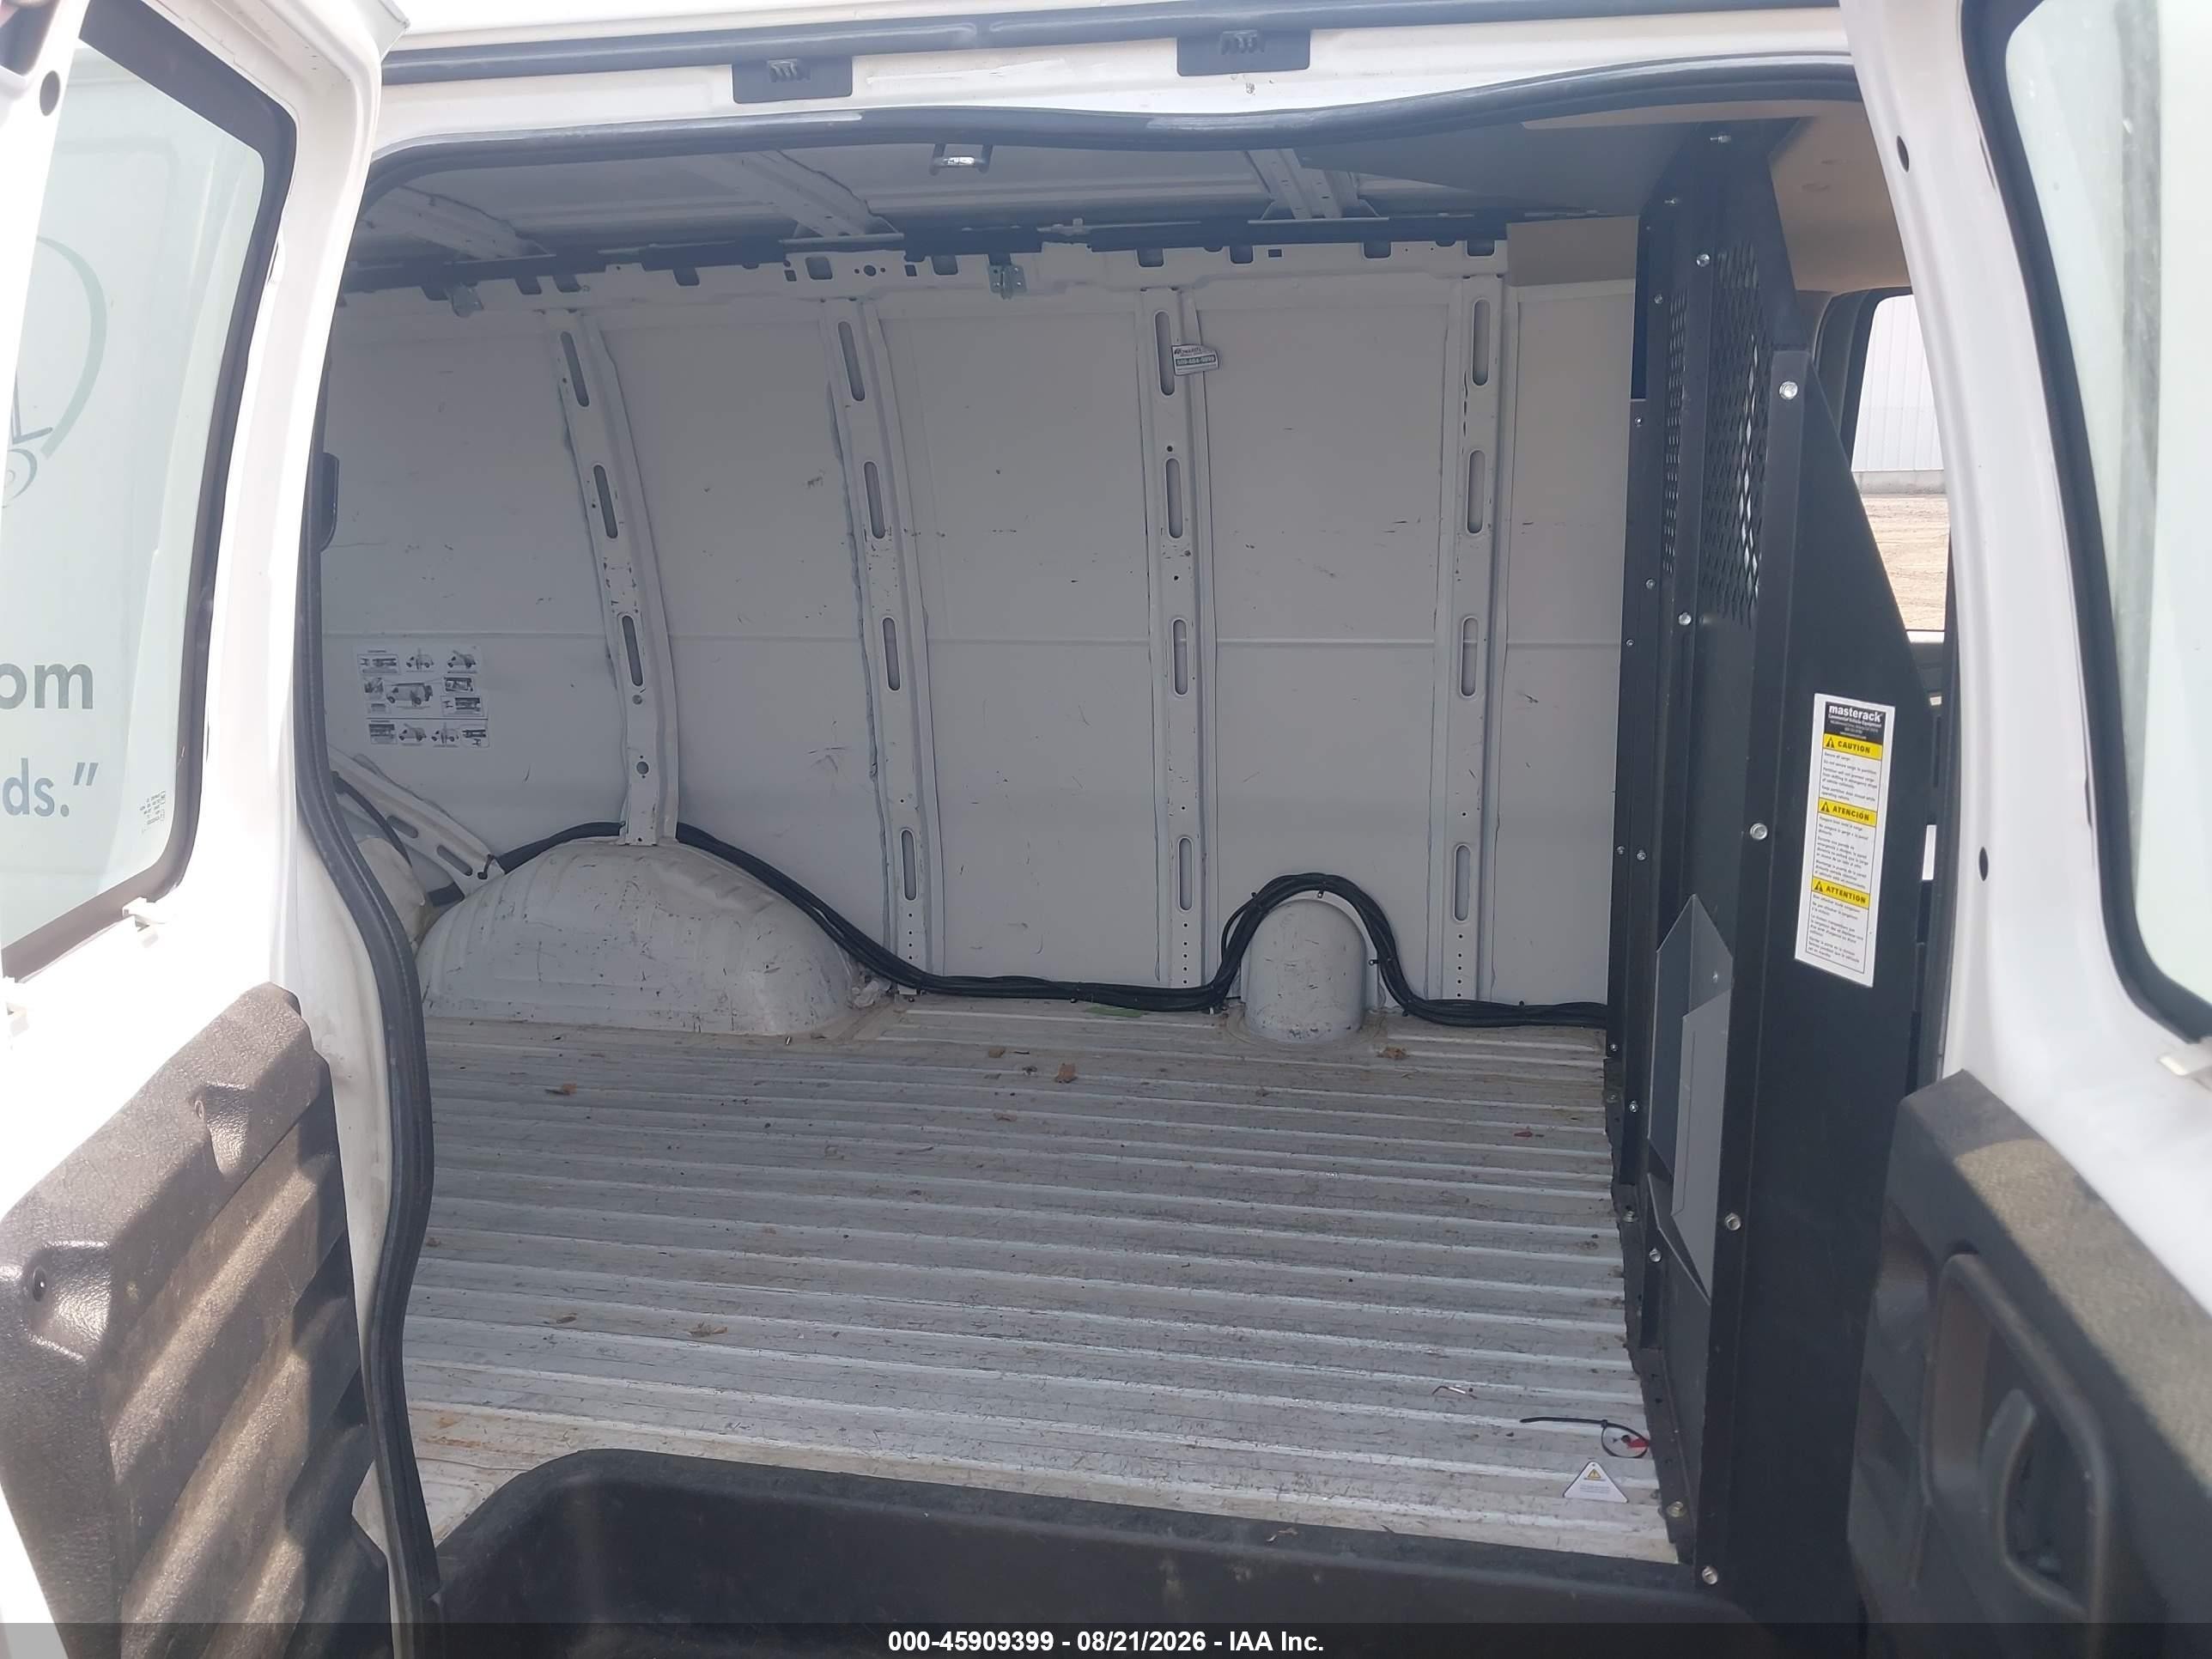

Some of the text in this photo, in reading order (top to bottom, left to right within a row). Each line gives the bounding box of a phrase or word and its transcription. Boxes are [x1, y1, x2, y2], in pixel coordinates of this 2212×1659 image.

[1828, 705, 1881, 723] masterack
[1838, 740, 1870, 753] CAUTION
[1832, 805, 1869, 821] ATENCIÓN
[1826, 885, 1866, 903] ATTENTION
